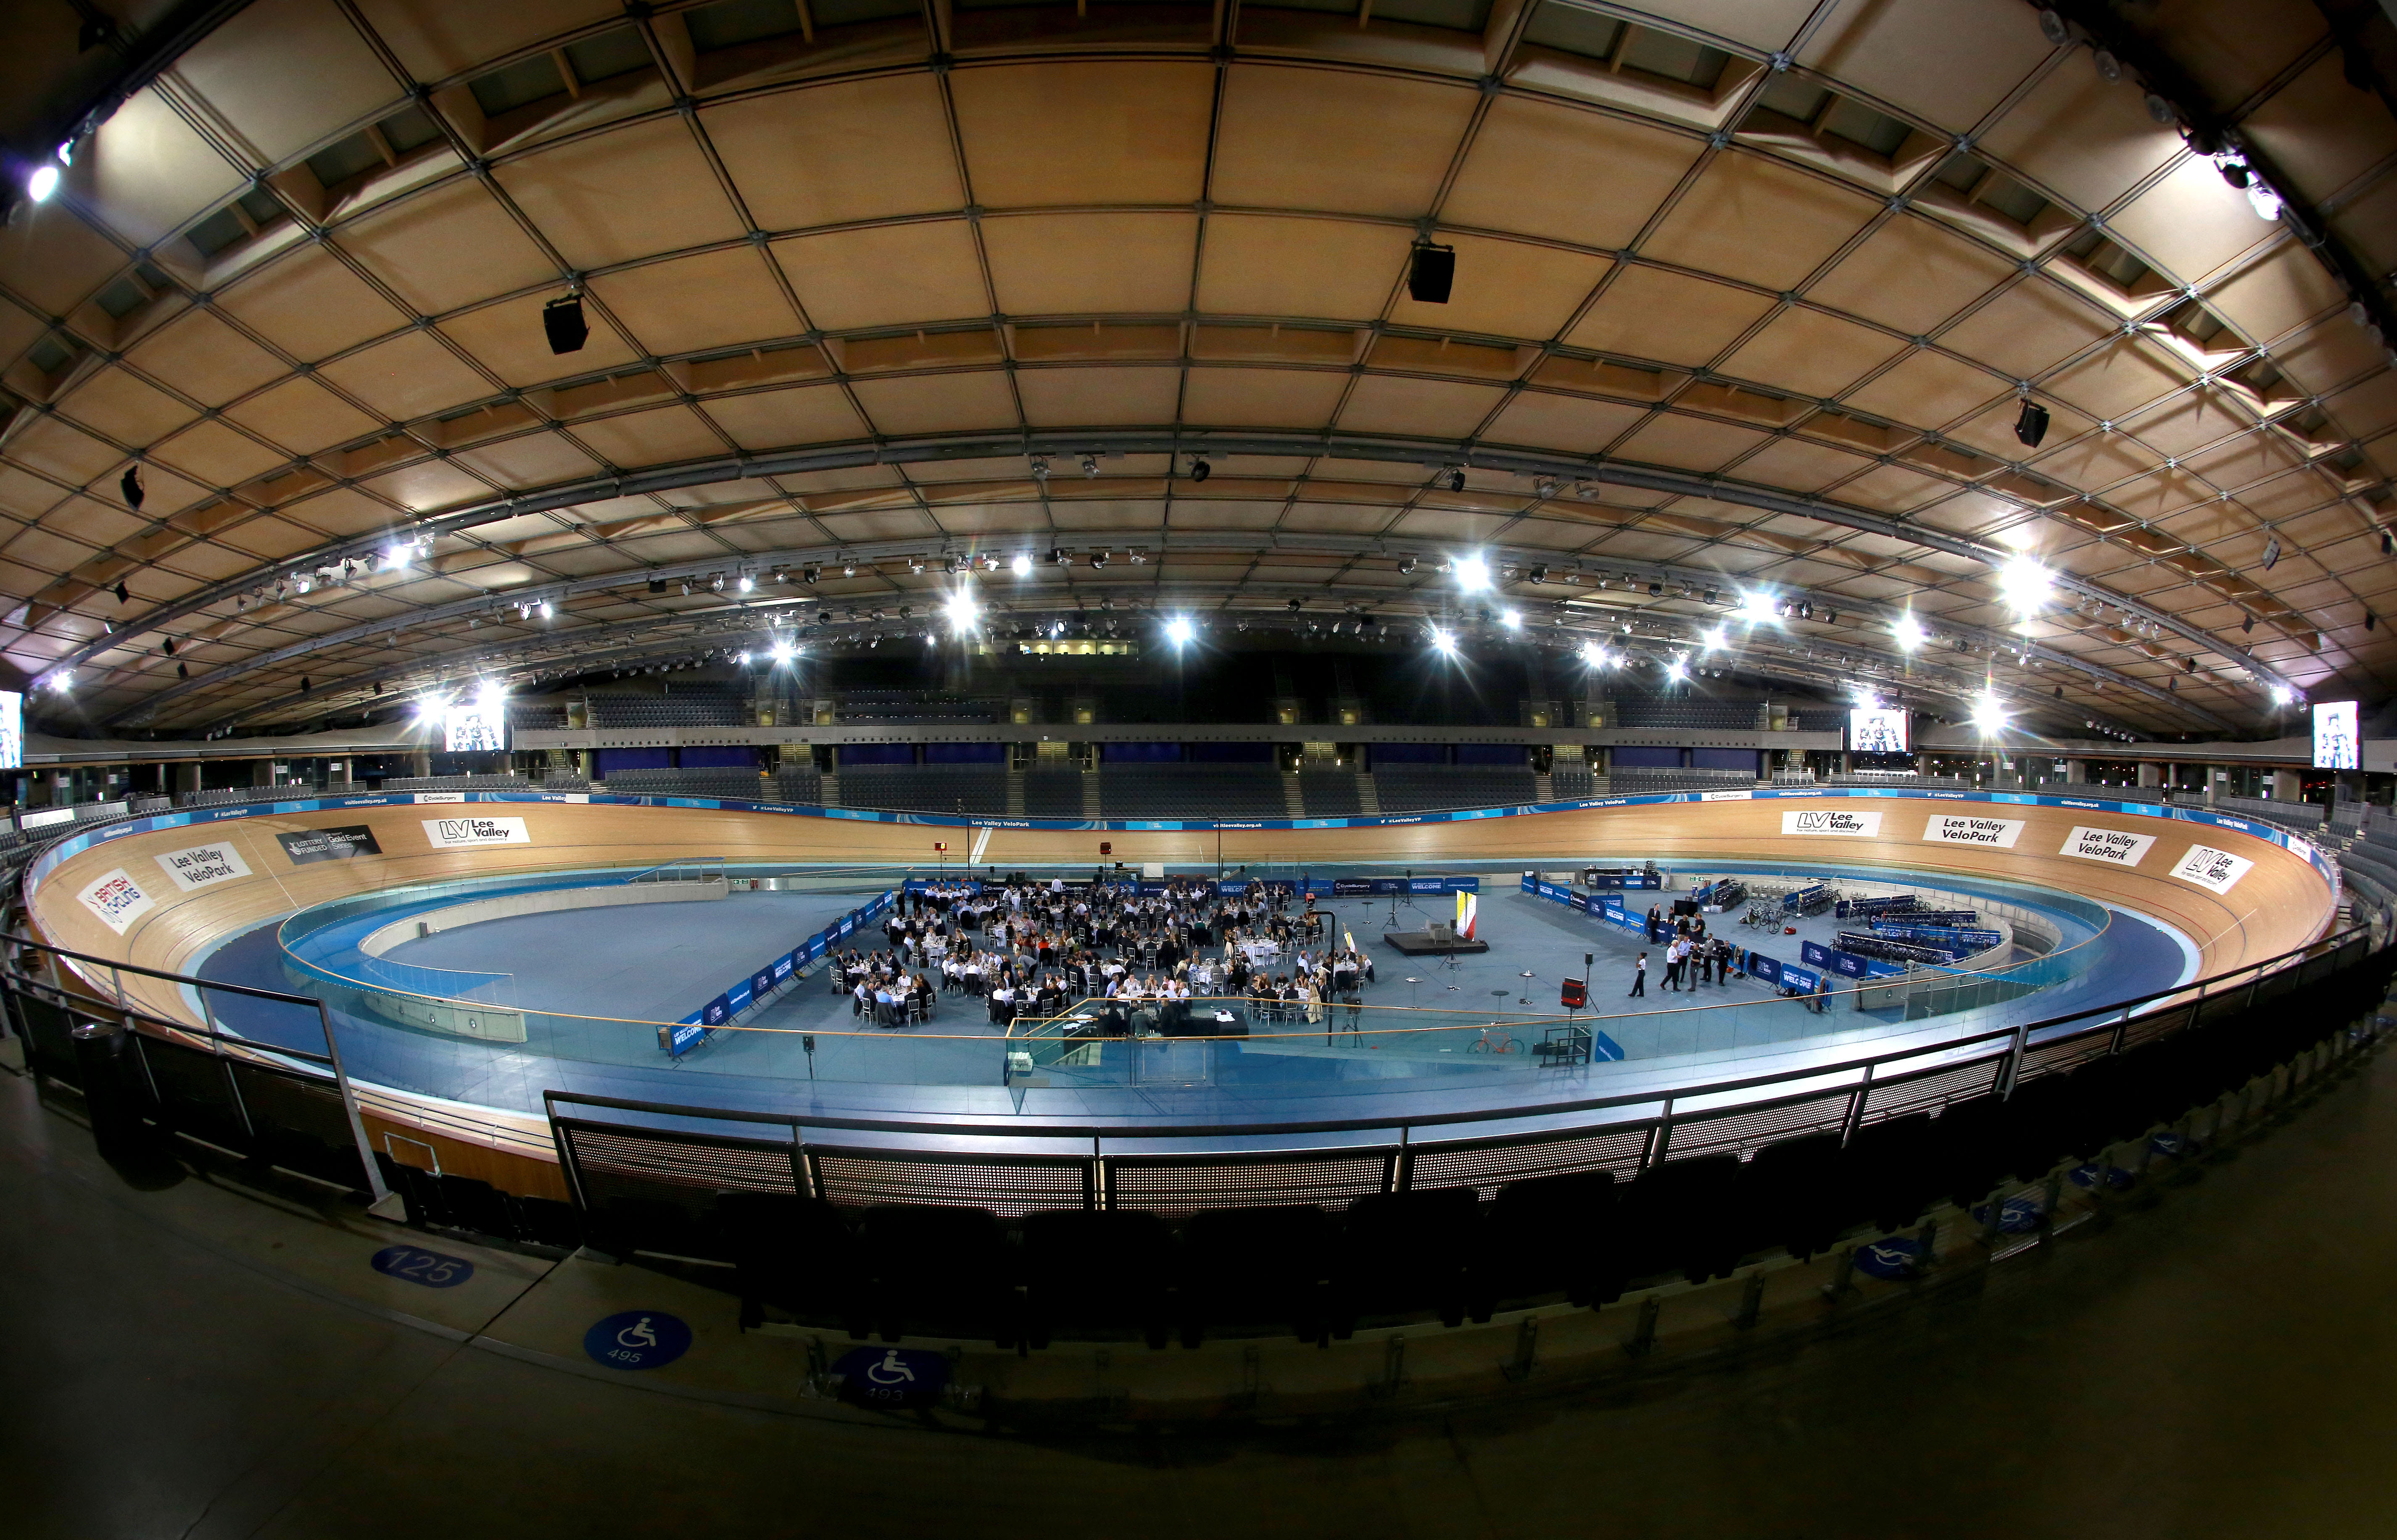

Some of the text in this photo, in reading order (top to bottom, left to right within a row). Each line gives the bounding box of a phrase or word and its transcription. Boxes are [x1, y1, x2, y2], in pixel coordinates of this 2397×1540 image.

[473, 828, 509, 837] Valley
[1830, 820, 1864, 830] Valley
[1944, 819, 2006, 833] Lee Valley
[297, 838, 322, 847] LOTTERY
[1943, 829, 1999, 842] VeloPark
[2083, 831, 2138, 849] Lee Valley
[301, 845, 327, 854] FUNDED
[2078, 843, 2127, 860] VeloPark
[169, 849, 224, 869] Lee Valley
[2215, 854, 2233, 868] Lee
[183, 862, 235, 883] VeloPark
[2207, 865, 2230, 883] Valley
[94, 876, 131, 903] BRITISH
[107, 887, 141, 914] CYCLING
[1606, 911, 1624, 921] WELCOME
[775, 962, 791, 978] WELCOME
[1783, 974, 1812, 989] WELCOME
[675, 1023, 702, 1045] WELCOME
[679, 1026, 689, 1035] VALLEY
[387, 1250, 462, 1282] 125
[607, 1349, 642, 1362] 495
[864, 1387, 904, 1402] 493
